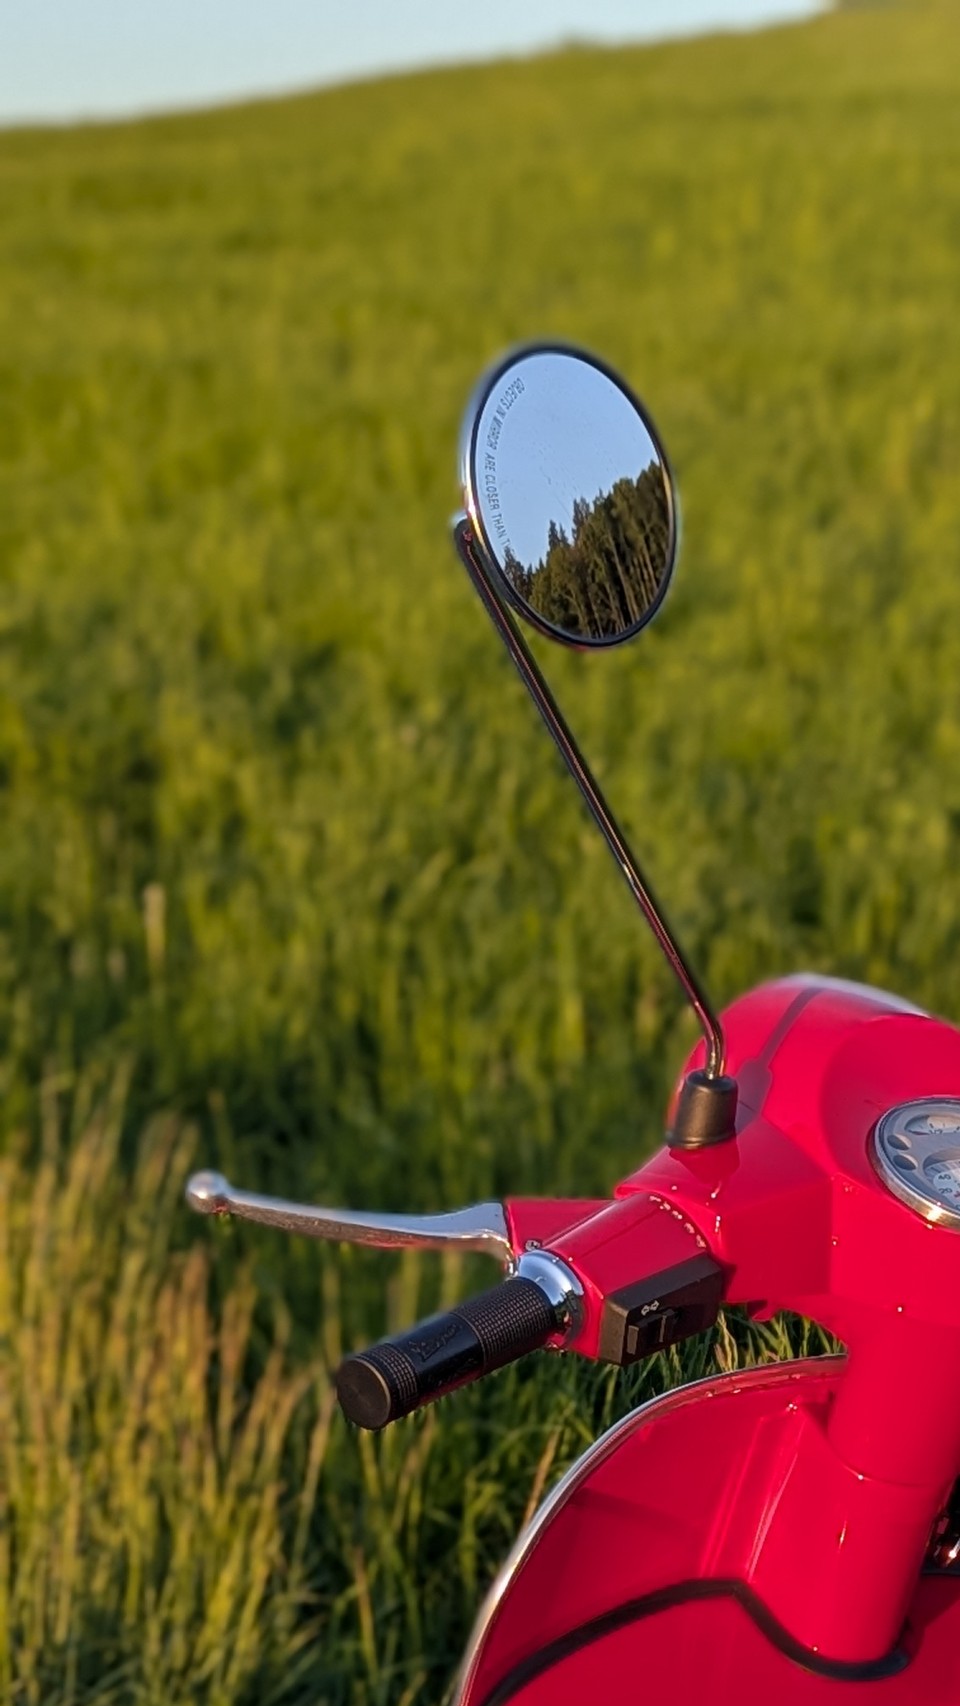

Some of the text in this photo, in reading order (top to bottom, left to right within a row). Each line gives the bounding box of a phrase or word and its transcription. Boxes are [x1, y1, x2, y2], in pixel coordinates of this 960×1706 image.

[501, 377, 526, 410] OBJECTS
[486, 417, 503, 450] MIRROR
[485, 453, 496, 471] ARE
[485, 473, 500, 510] CLOSER
[491, 513, 507, 539] THAN
